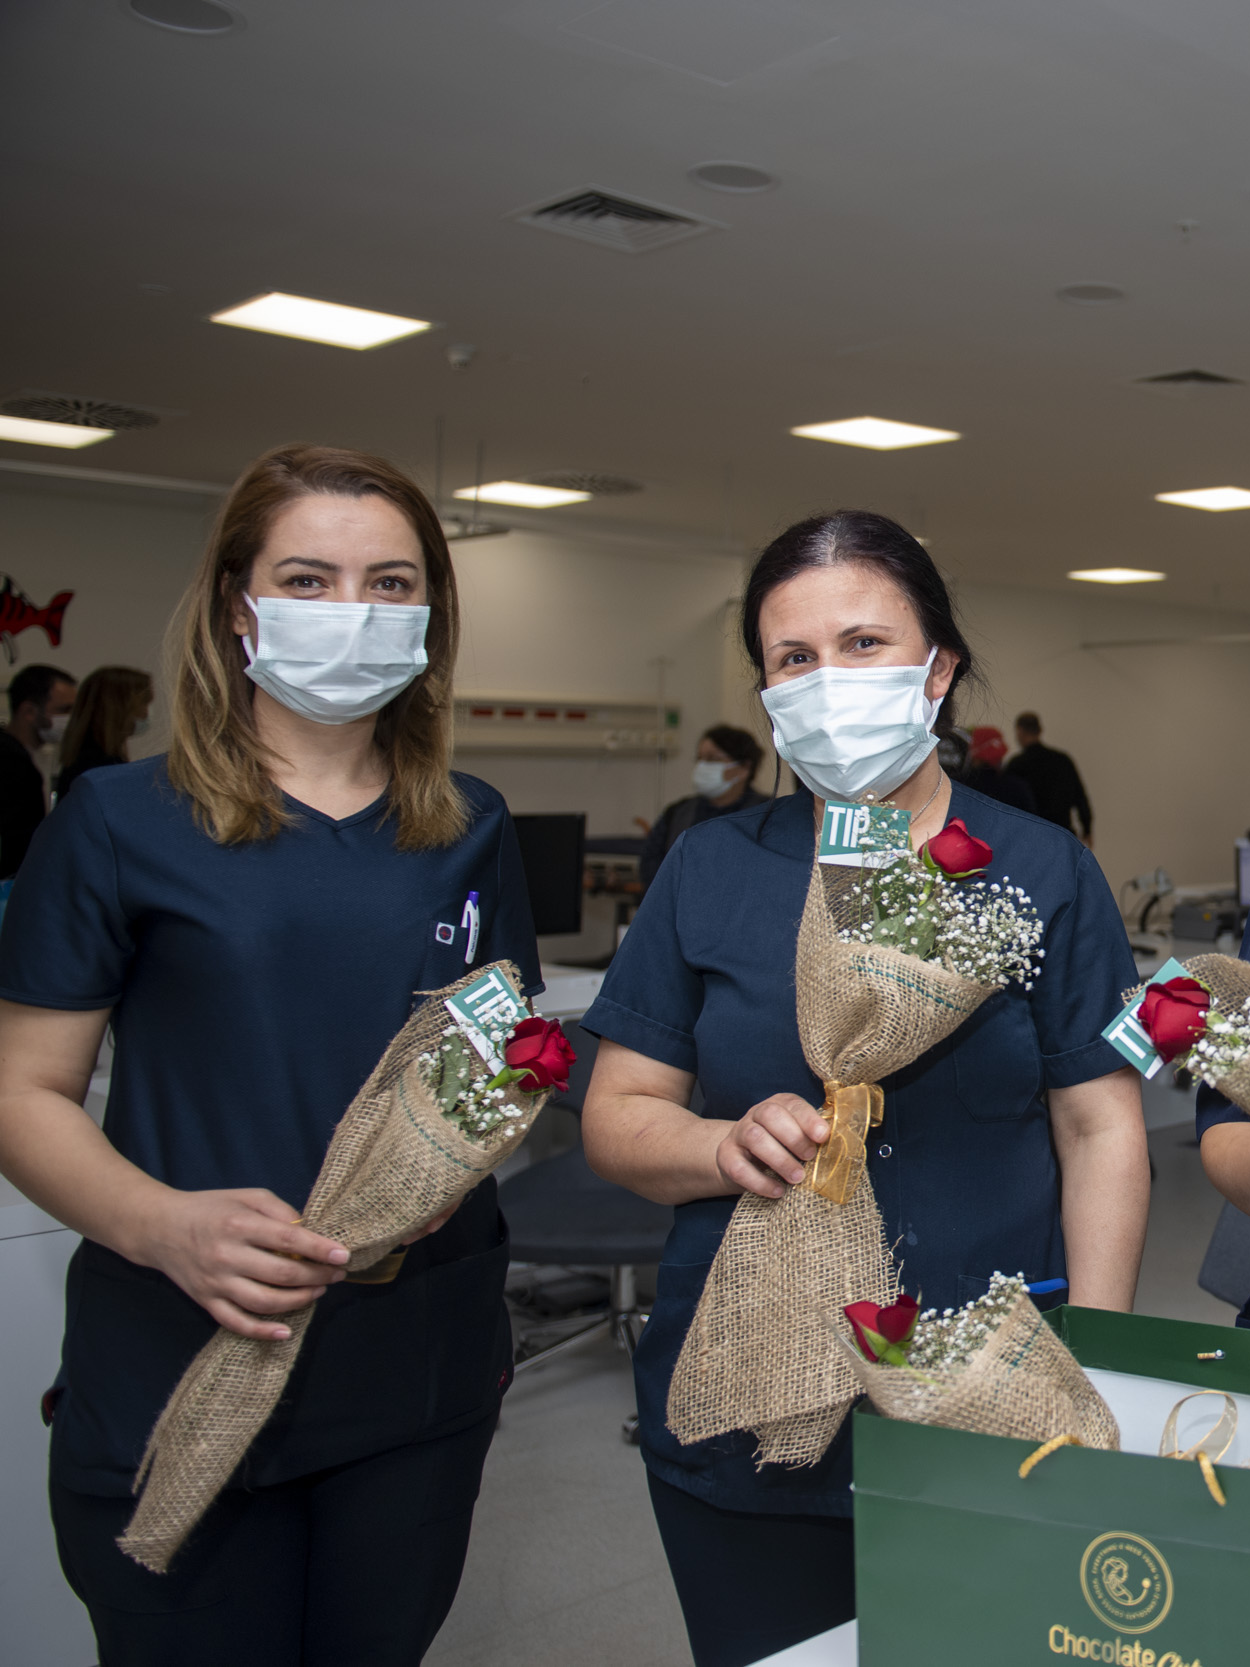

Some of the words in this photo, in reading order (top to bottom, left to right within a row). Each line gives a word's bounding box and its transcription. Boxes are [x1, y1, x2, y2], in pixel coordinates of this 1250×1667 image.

[827, 806, 870, 848] TIP
[464, 973, 518, 1024] TIP
[1049, 1624, 1156, 1667] Chocolate
